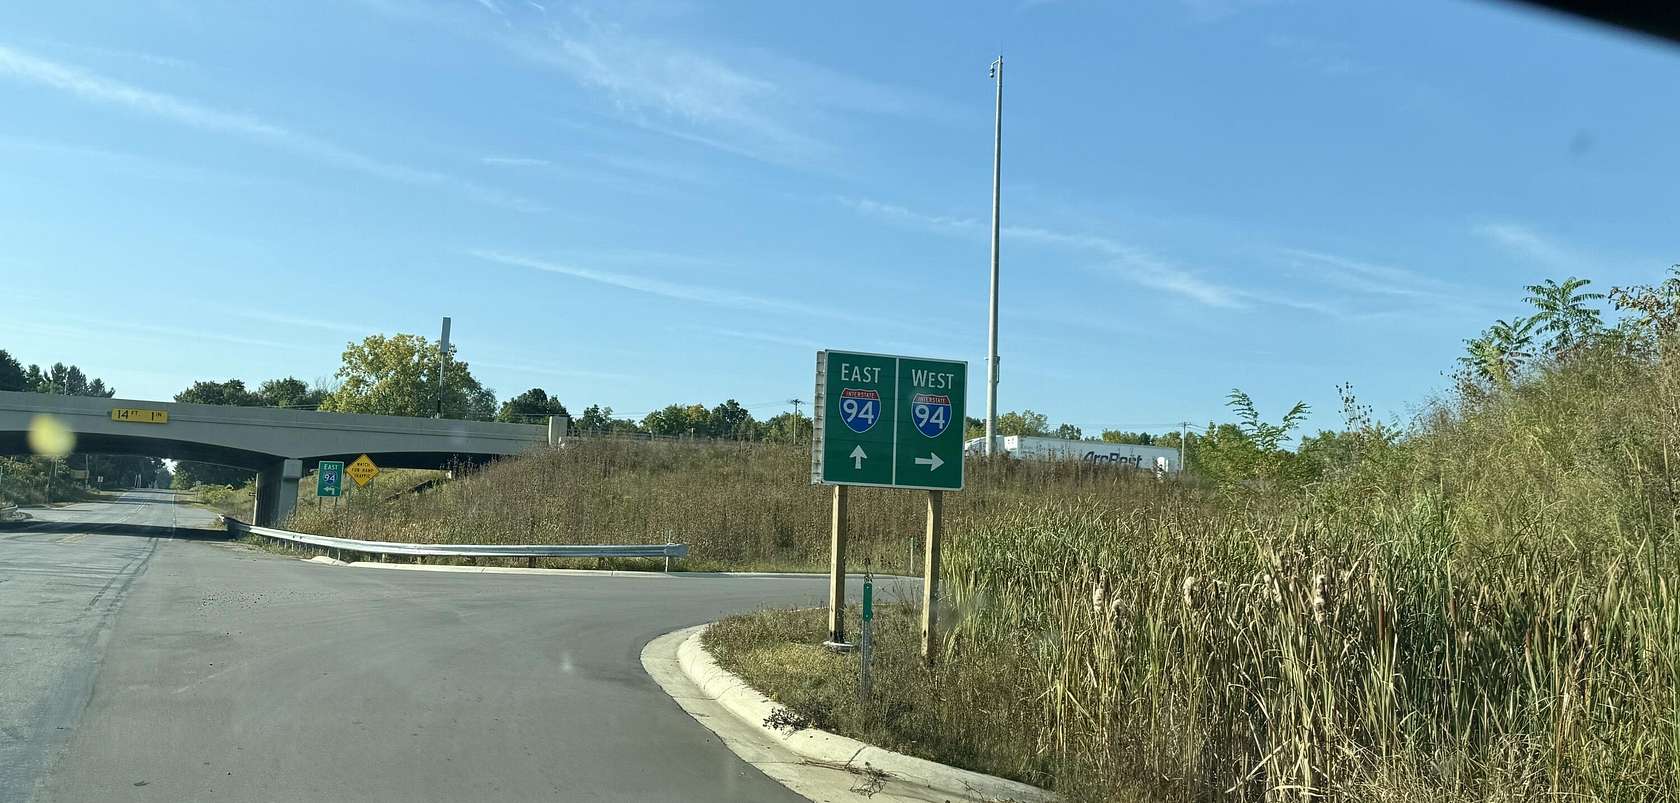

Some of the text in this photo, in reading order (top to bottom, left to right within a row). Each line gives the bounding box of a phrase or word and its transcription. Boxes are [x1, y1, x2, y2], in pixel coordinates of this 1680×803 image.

[841, 363, 881, 384] EAST
[911, 369, 955, 390] WEST
[846, 391, 876, 399] INTERSTATE
[917, 396, 947, 404] INTERSTATE
[117, 410, 128, 419] 14
[151, 411, 155, 422] 1
[843, 399, 875, 425] 94
[915, 404, 946, 430] 94
[324, 473, 336, 482] 94
